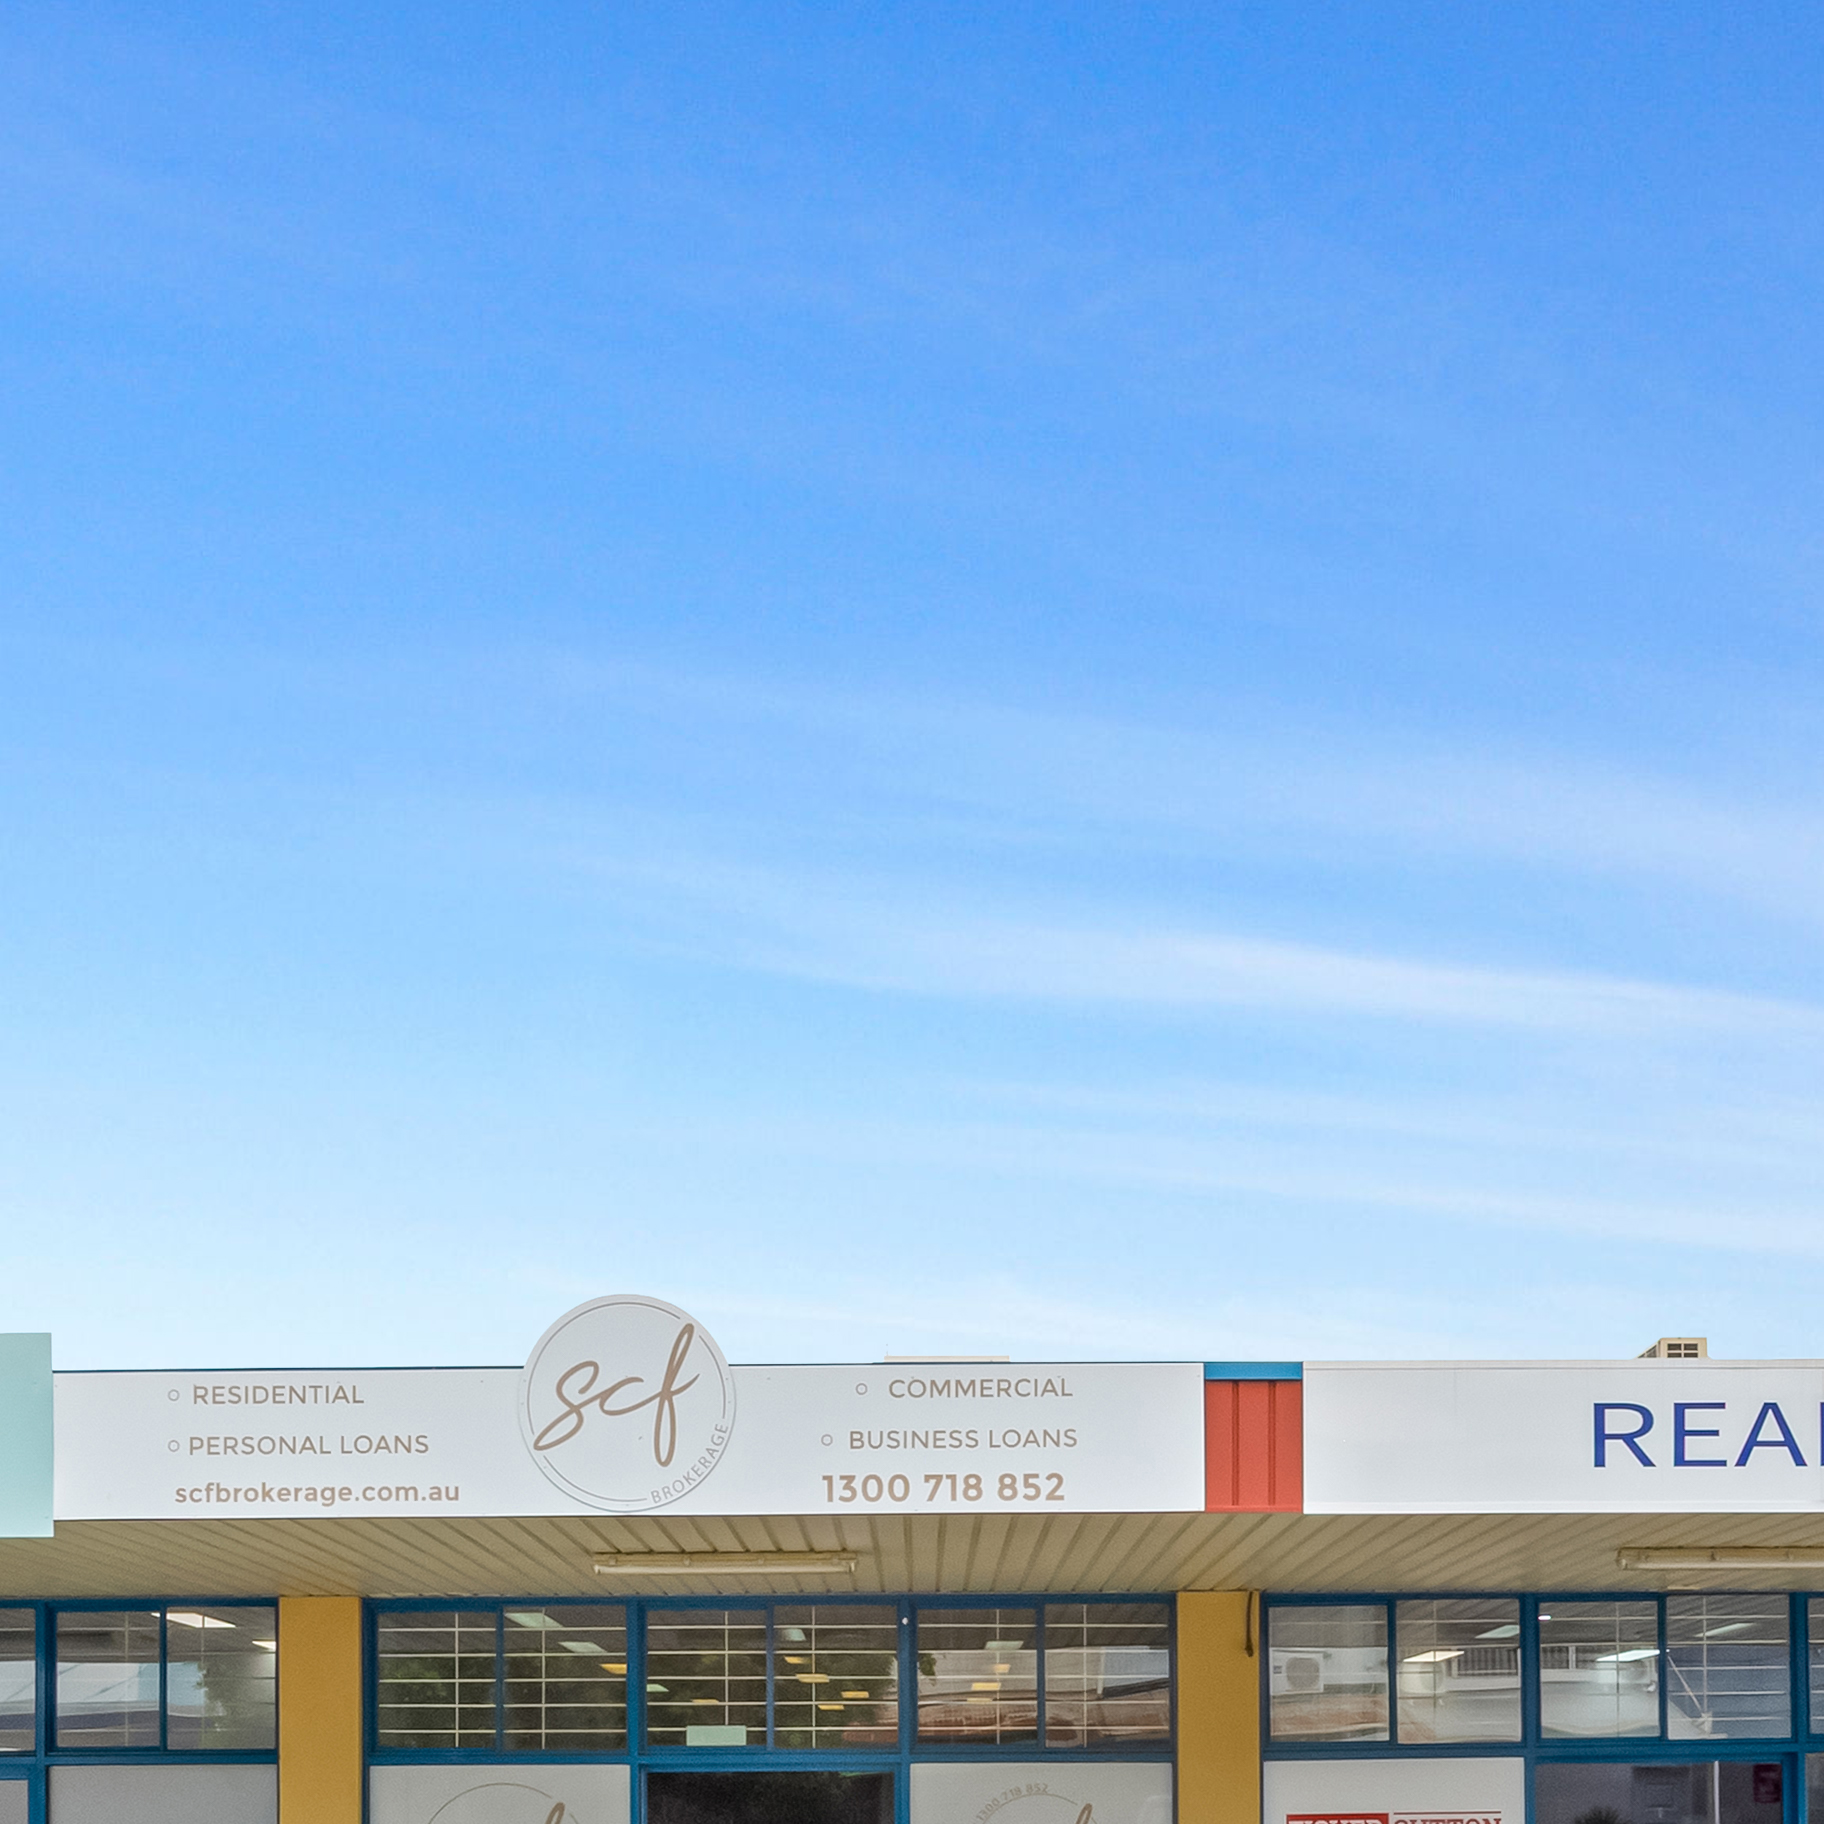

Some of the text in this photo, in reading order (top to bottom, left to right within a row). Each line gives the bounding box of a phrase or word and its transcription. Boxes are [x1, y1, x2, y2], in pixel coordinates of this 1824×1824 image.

[193, 1384, 365, 1405] RESIDENTIAL
[533, 1322, 700, 1468] scf
[888, 1377, 1074, 1399] COMMERCIAL
[189, 1434, 429, 1456] PERSONAL LOANS
[849, 1428, 1078, 1450] BUSINESS LOANS
[650, 1423, 729, 1504] BROKERAGE
[174, 1481, 460, 1508] scfbrokerage.com.au
[821, 1472, 1065, 1503] 1300 718 852
